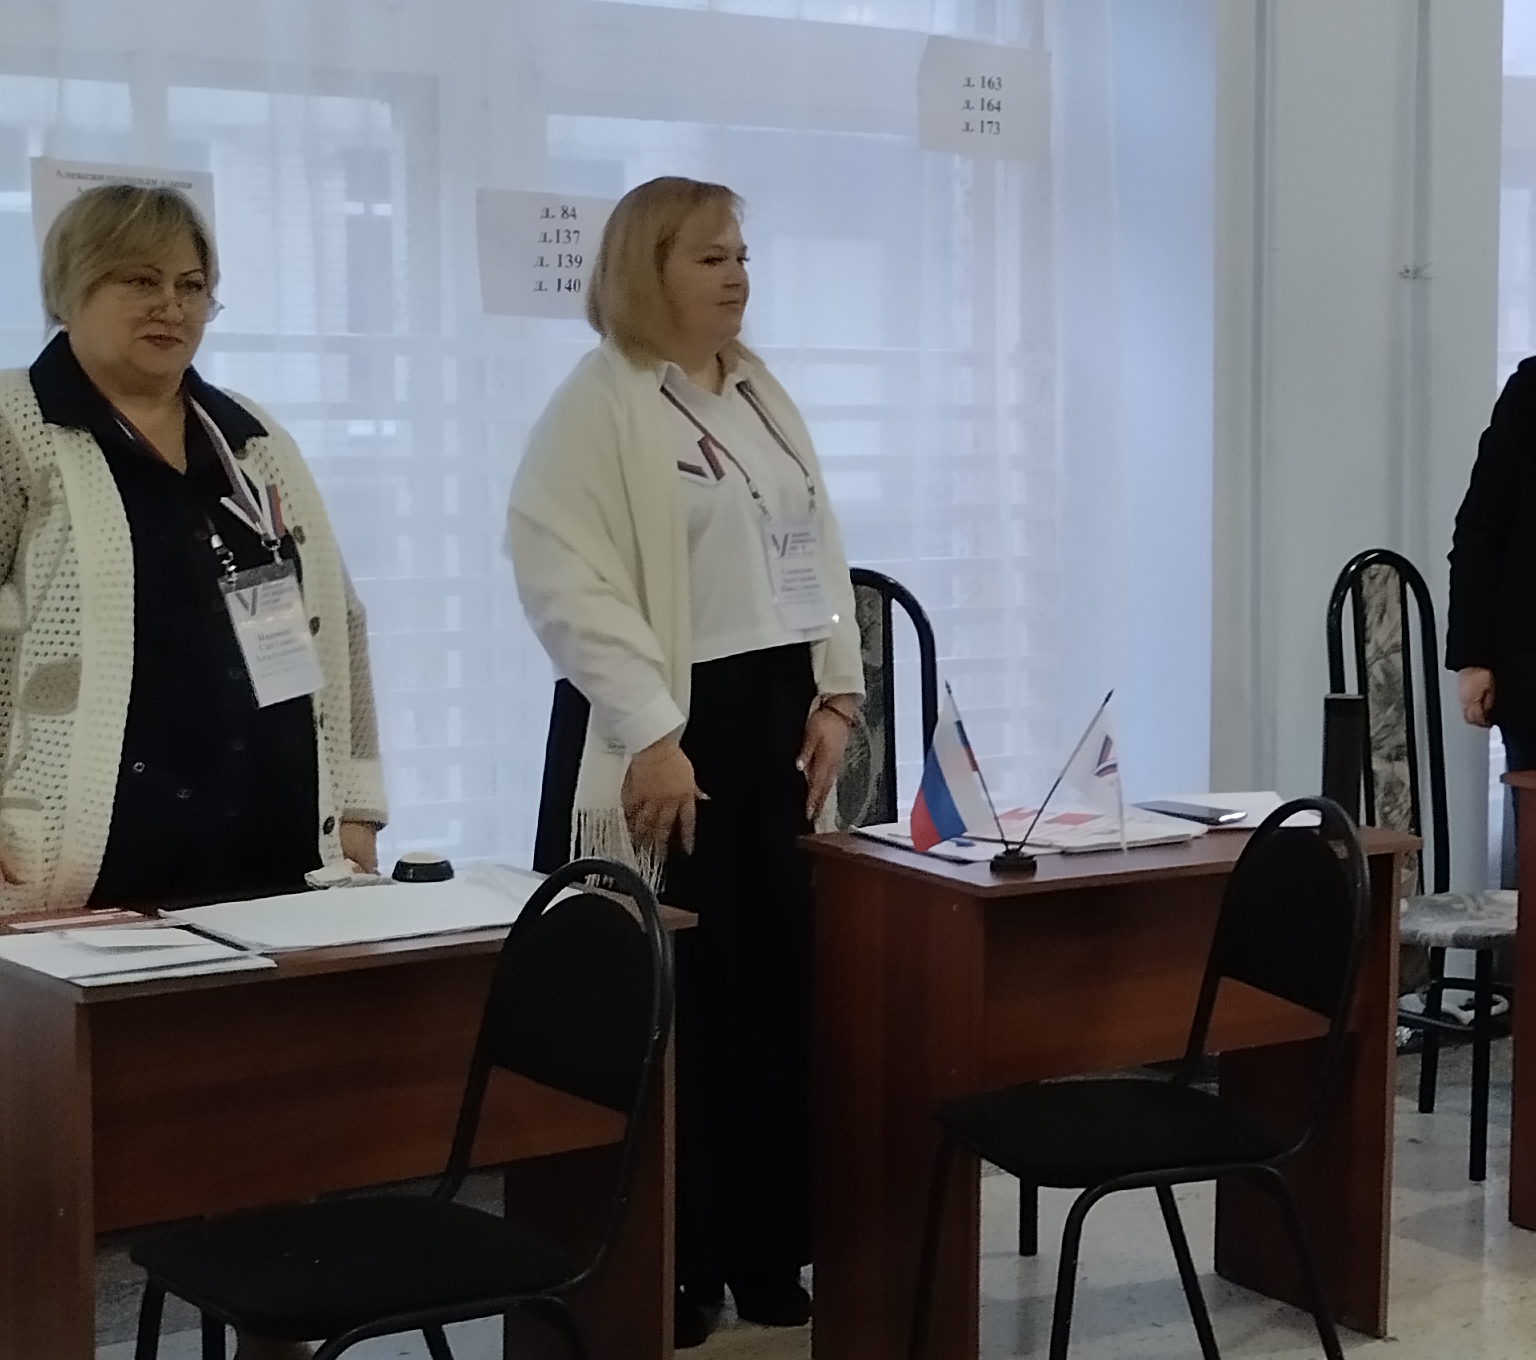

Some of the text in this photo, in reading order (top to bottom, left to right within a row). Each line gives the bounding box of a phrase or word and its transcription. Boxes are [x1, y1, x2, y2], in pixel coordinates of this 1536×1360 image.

[980, 75, 1003, 91] 163
[980, 97, 1001, 113] 164
[980, 120, 1001, 136] 173
[561, 204, 577, 220] 84
[557, 253, 583, 269] 139
[556, 277, 582, 293] 140
